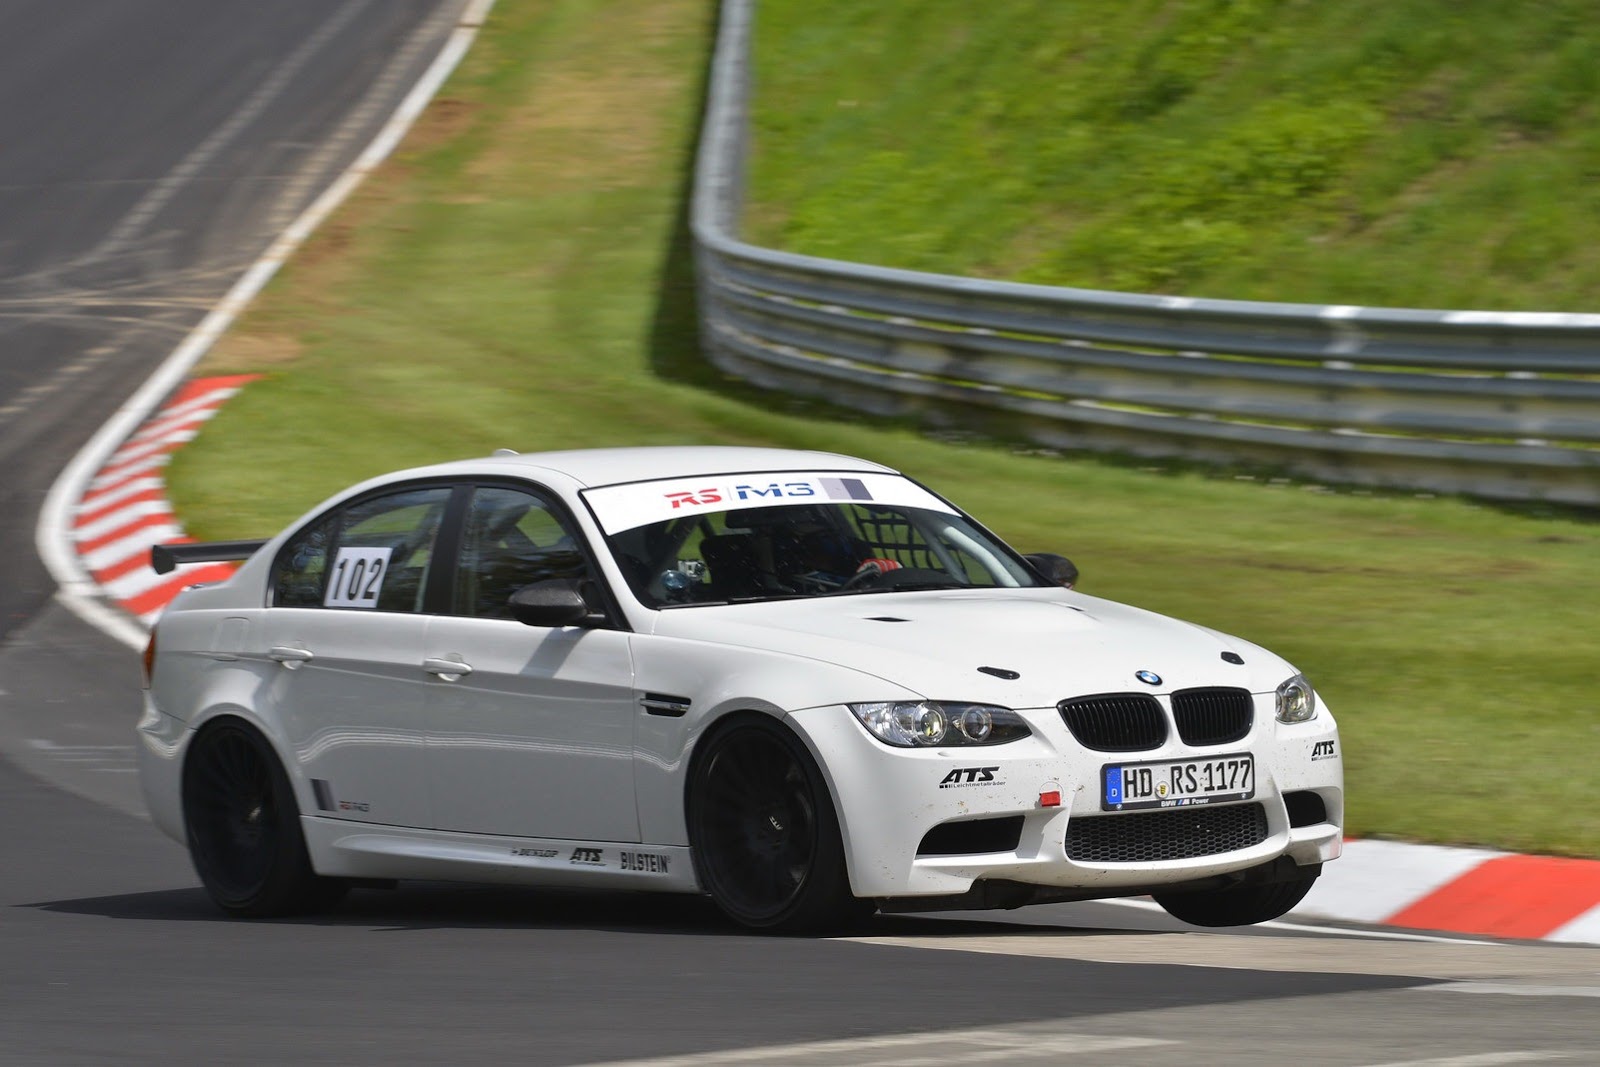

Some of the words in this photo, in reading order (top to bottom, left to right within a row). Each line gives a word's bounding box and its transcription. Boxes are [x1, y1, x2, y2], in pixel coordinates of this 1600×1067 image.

[664, 488, 722, 508] RS
[735, 482, 815, 500] M3
[332, 558, 383, 600] 102
[1311, 740, 1334, 756] ATS
[940, 766, 1000, 784] ATS
[1124, 768, 1152, 798] HD
[1171, 764, 1198, 794] RS
[1203, 758, 1250, 792] 1177
[1111, 788, 1118, 797] D
[1161, 800, 1176, 808] BMW
[1192, 797, 1210, 805] Power
[569, 847, 603, 862] ATS
